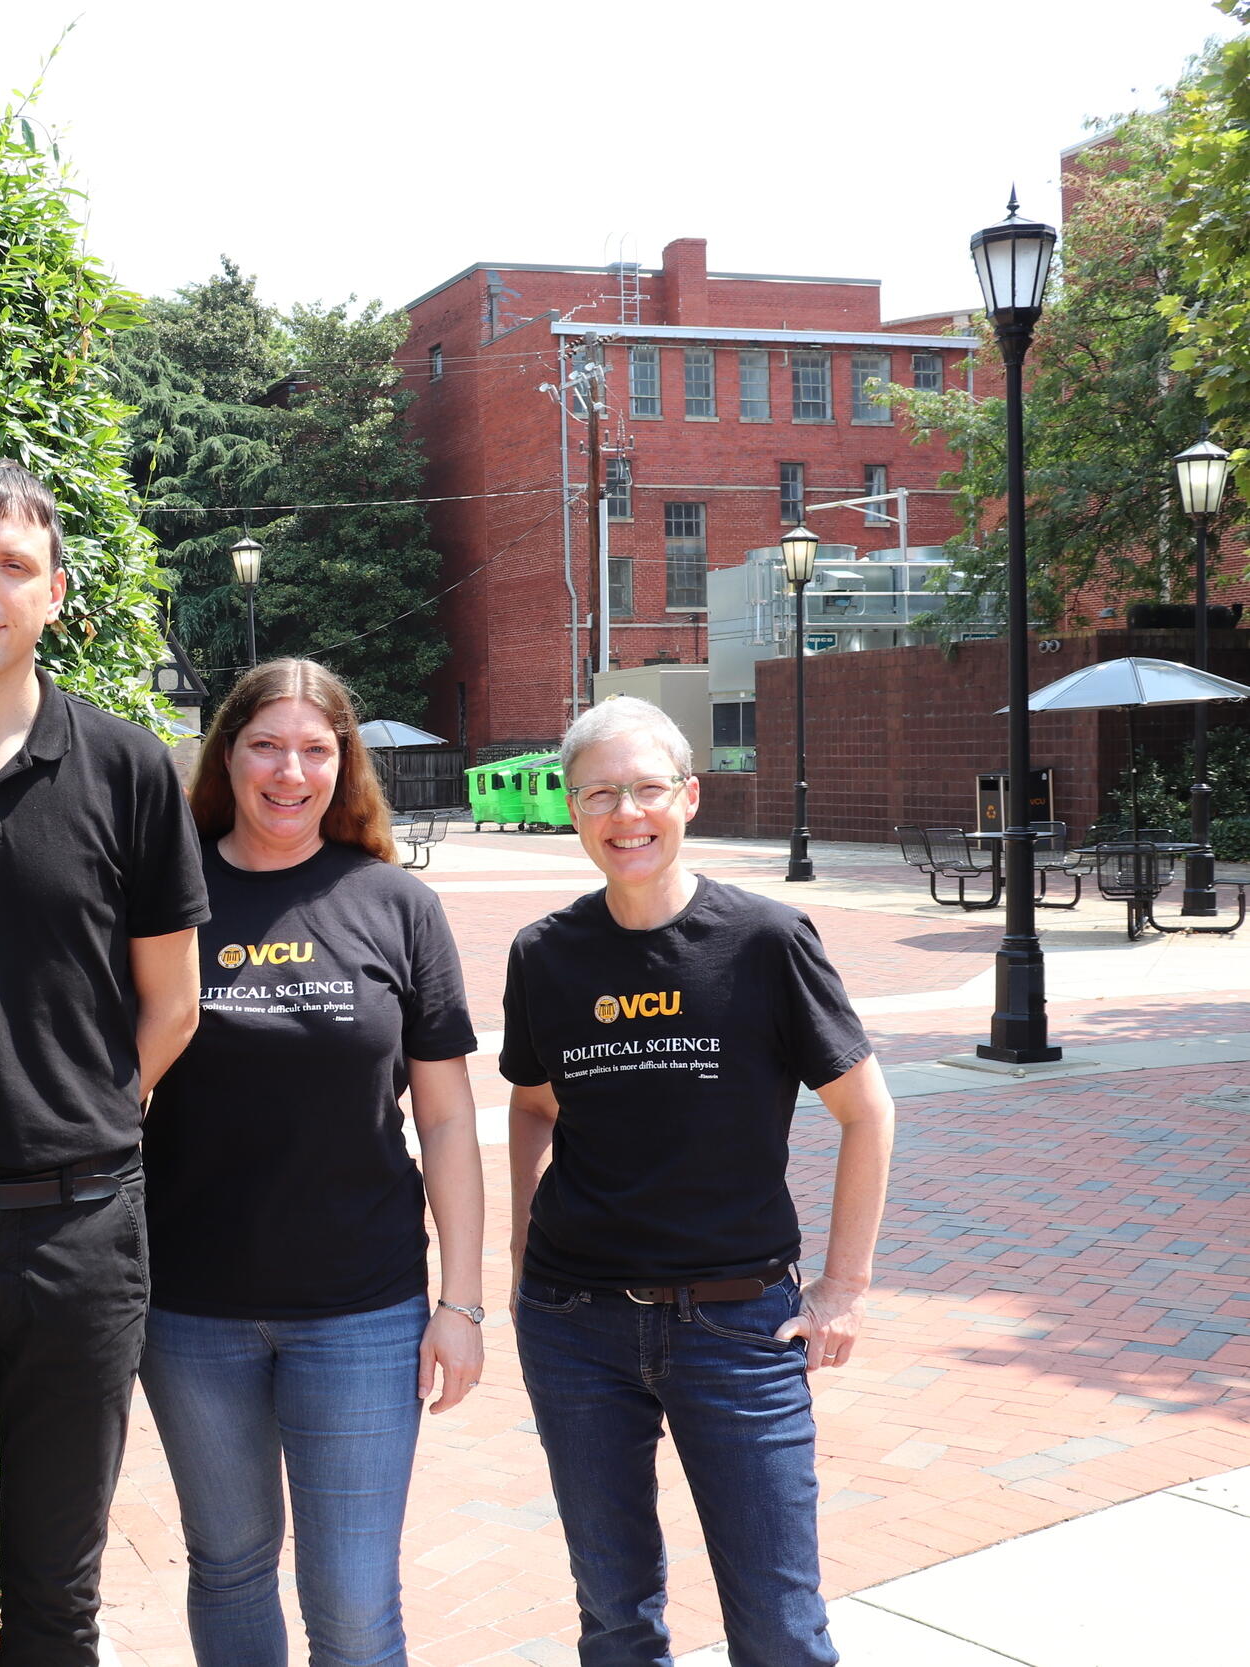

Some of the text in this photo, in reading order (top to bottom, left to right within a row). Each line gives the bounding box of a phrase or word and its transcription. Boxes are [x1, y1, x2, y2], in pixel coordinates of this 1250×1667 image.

[247, 942, 313, 966] VCU
[198, 981, 354, 1000] LITICAL SCIENCE
[202, 1003, 233, 1012] politics
[244, 1005, 266, 1013] more
[267, 1003, 301, 1014] difficult
[302, 1003, 322, 1012] than
[323, 1001, 354, 1013] physics
[619, 990, 681, 1019] VCU
[562, 1037, 721, 1064] POLITICAL SCIENCE
[564, 1059, 719, 1080] because politics is more difficult than physics
